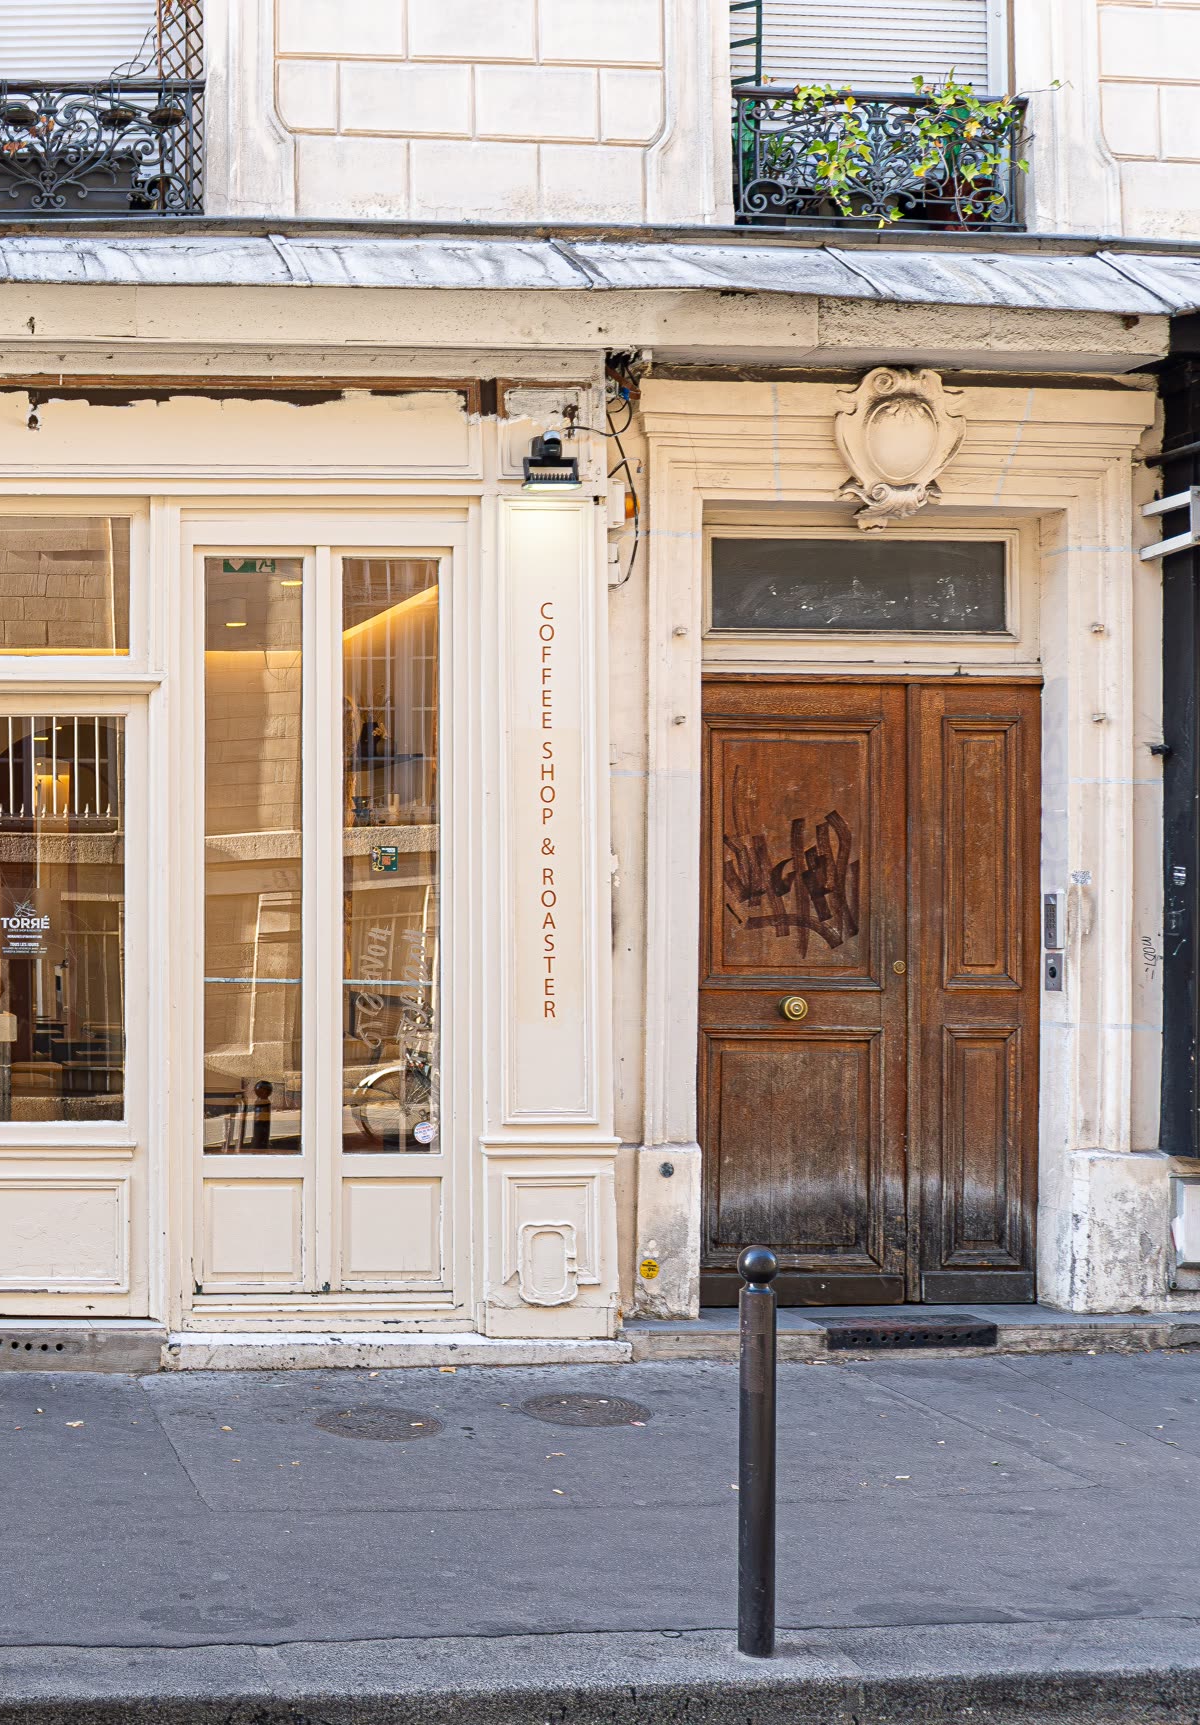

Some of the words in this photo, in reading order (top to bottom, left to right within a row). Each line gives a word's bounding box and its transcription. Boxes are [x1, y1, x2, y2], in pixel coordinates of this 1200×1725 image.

[538, 602, 554, 730] COFFEE
[540, 741, 556, 826] SHOP
[540, 838, 555, 856] &
[541, 868, 557, 1019] ROASTER
